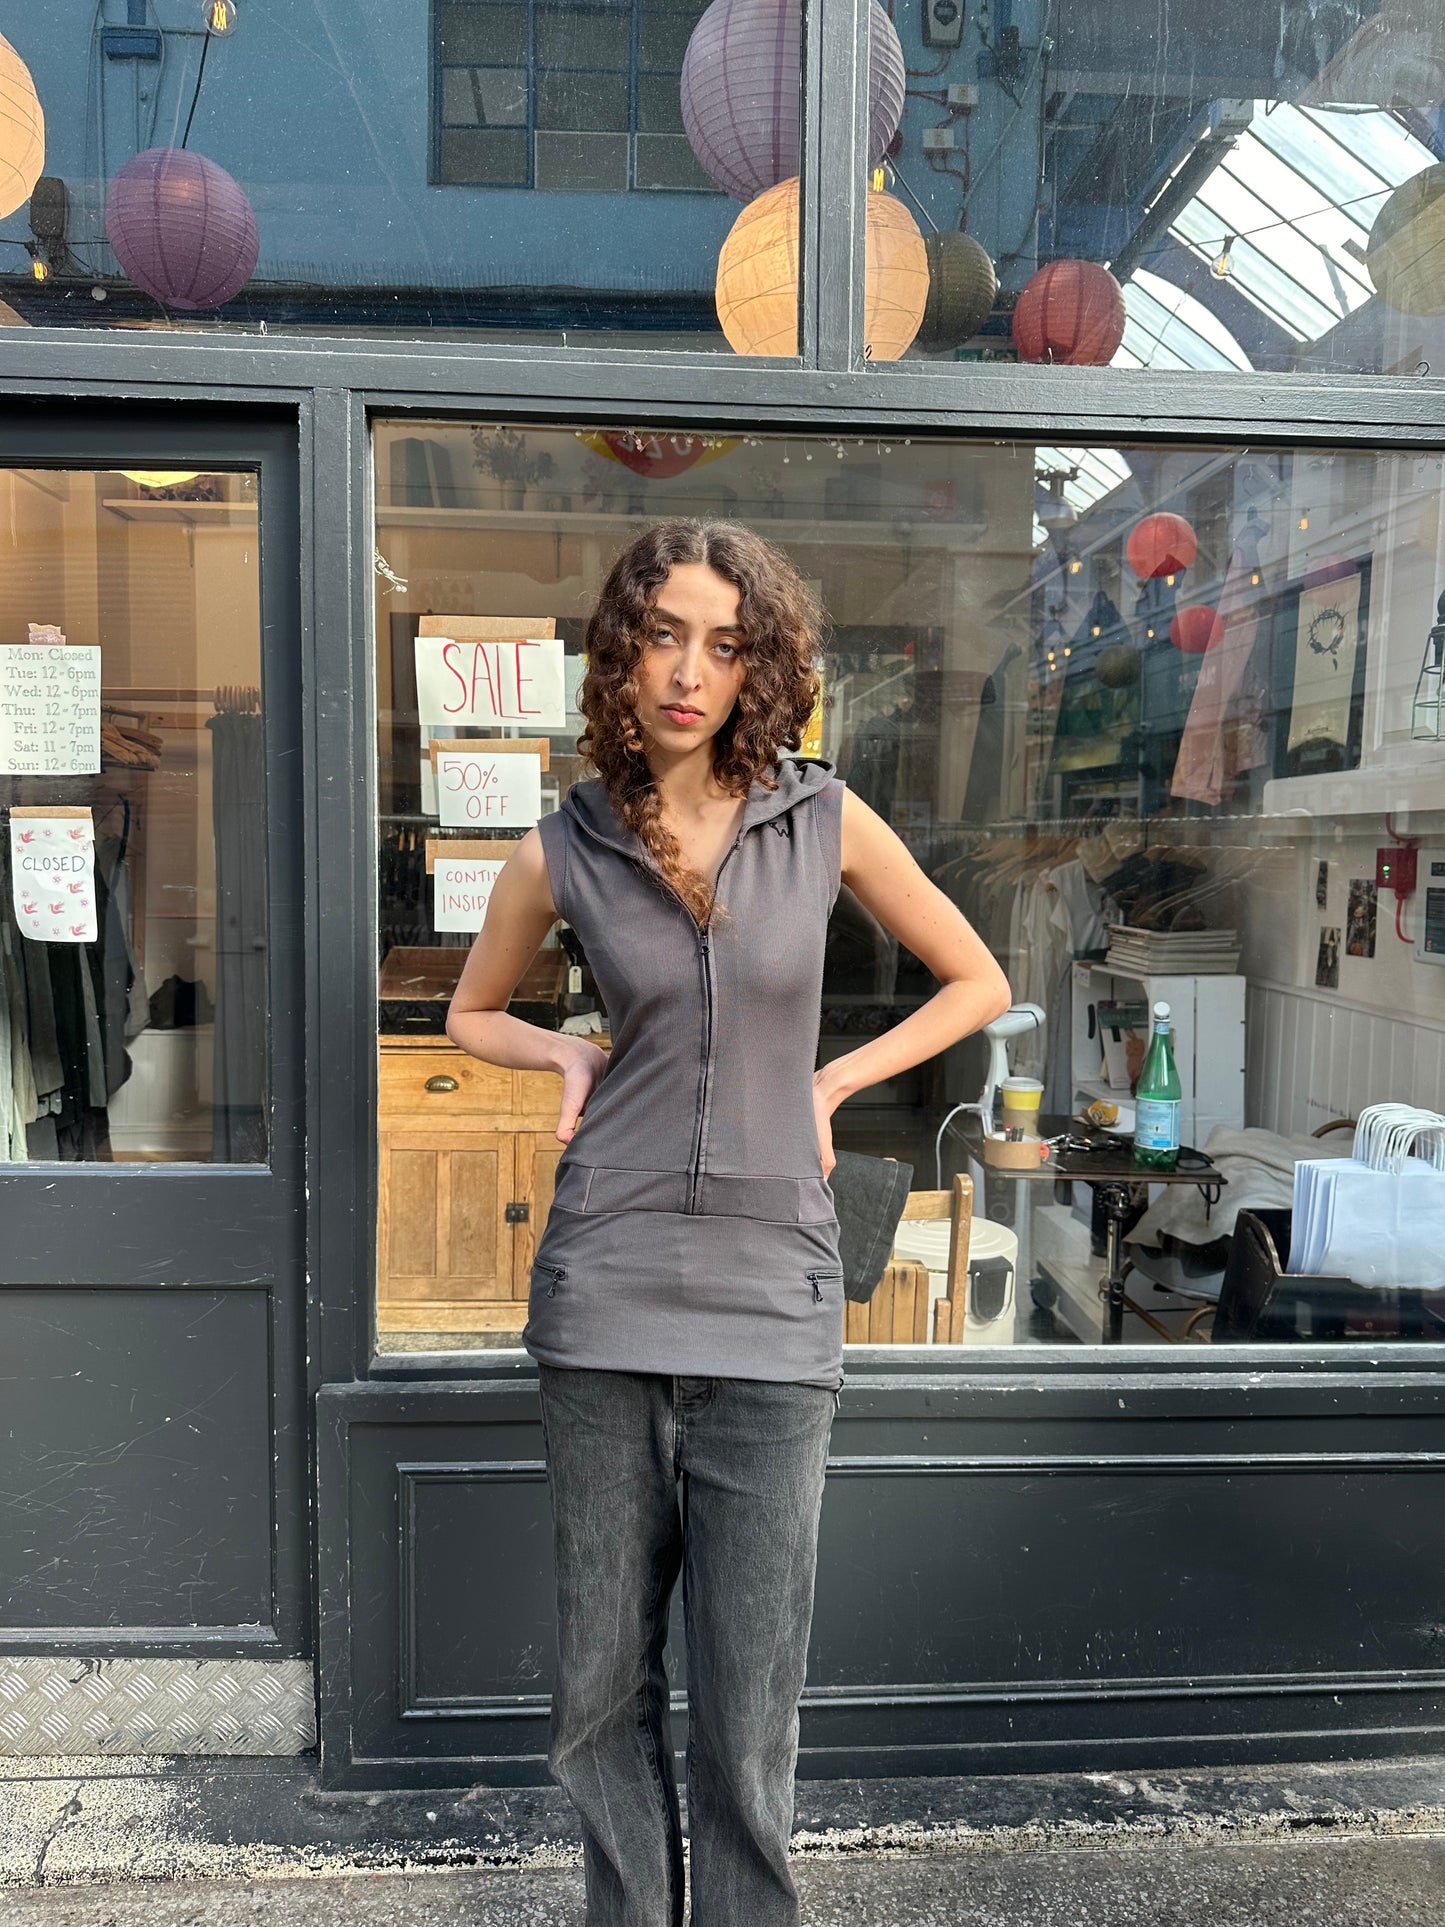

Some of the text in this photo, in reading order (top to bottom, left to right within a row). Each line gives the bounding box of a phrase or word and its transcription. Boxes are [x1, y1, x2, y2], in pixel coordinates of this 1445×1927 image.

[8, 647, 93, 661] Mon: Closed
[5, 666, 37, 679] Tue:
[442, 642, 541, 720] SALE
[3, 684, 42, 697] Wed:
[1, 703, 36, 716] Thu:
[13, 721, 38, 734] Fri:
[13, 740, 39, 753] Sat:
[8, 758, 40, 771] Sun:
[443, 760, 499, 792] 50%
[466, 795, 509, 819] OFF
[22, 855, 86, 873] CLOSED
